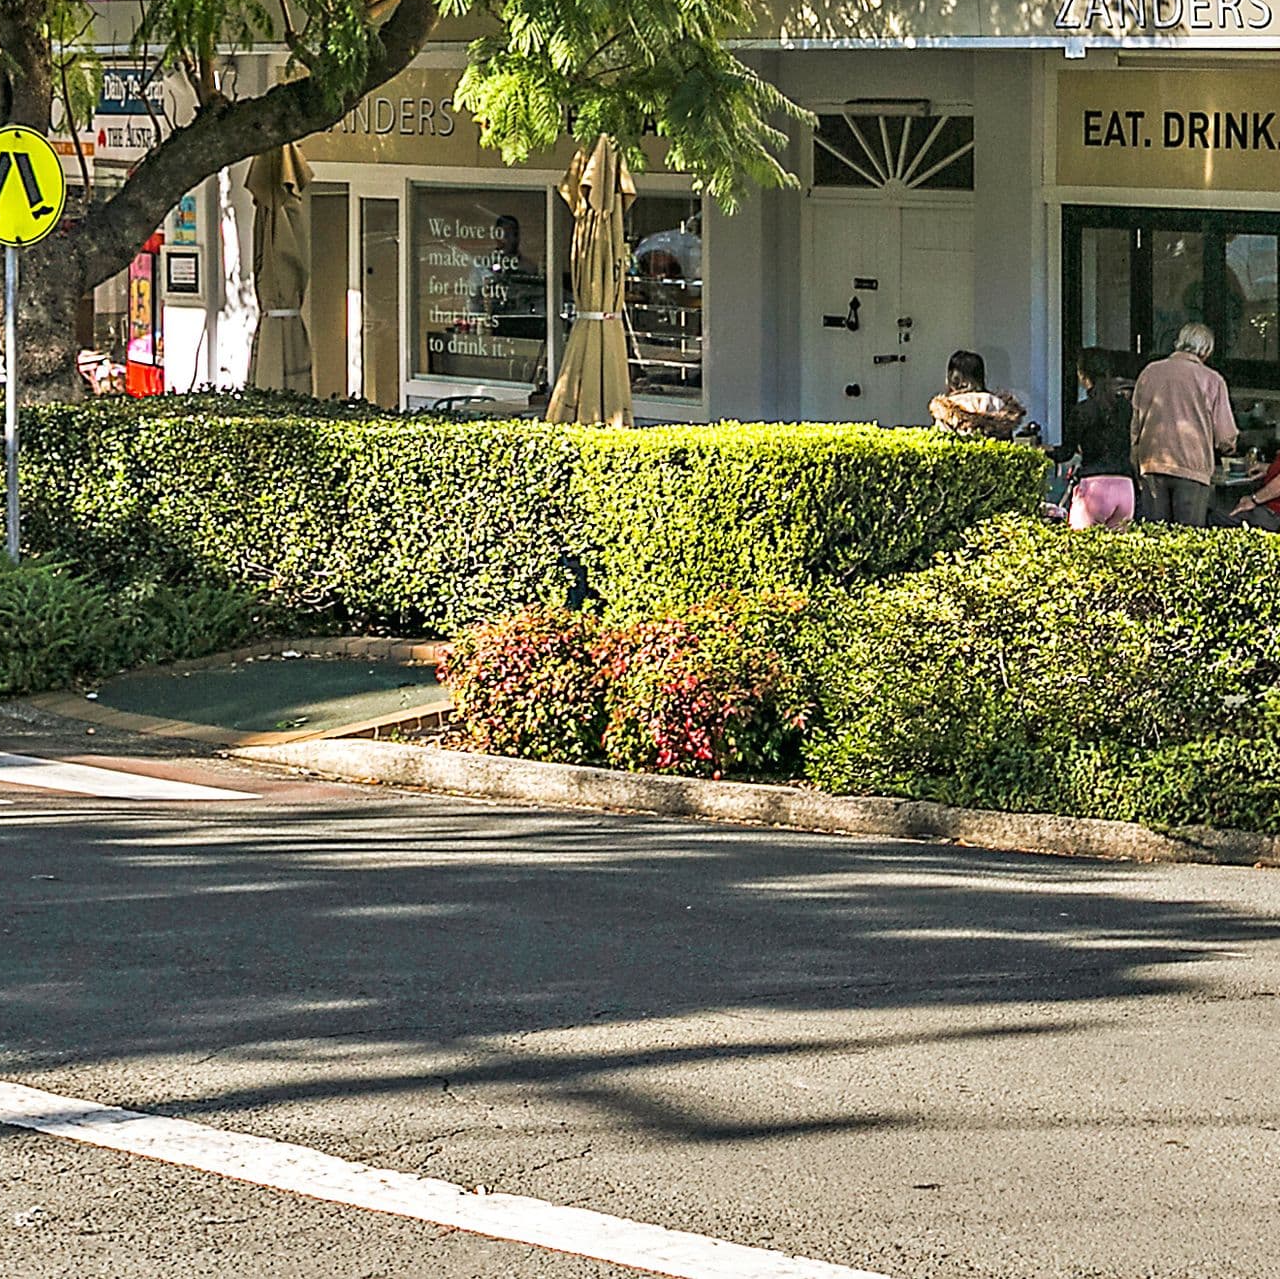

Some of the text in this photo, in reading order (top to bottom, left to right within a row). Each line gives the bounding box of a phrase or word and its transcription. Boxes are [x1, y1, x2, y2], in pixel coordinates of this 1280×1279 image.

[103, 72, 126, 108] Daily
[325, 96, 455, 136] NDERS
[107, 127, 123, 148] THE
[1084, 110, 1151, 147] EAT.
[429, 218, 505, 240] We love to
[429, 248, 519, 271] make coffee
[429, 275, 509, 301] for the city
[429, 304, 456, 324] that
[429, 337, 444, 352] to
[447, 335, 488, 357] drink
